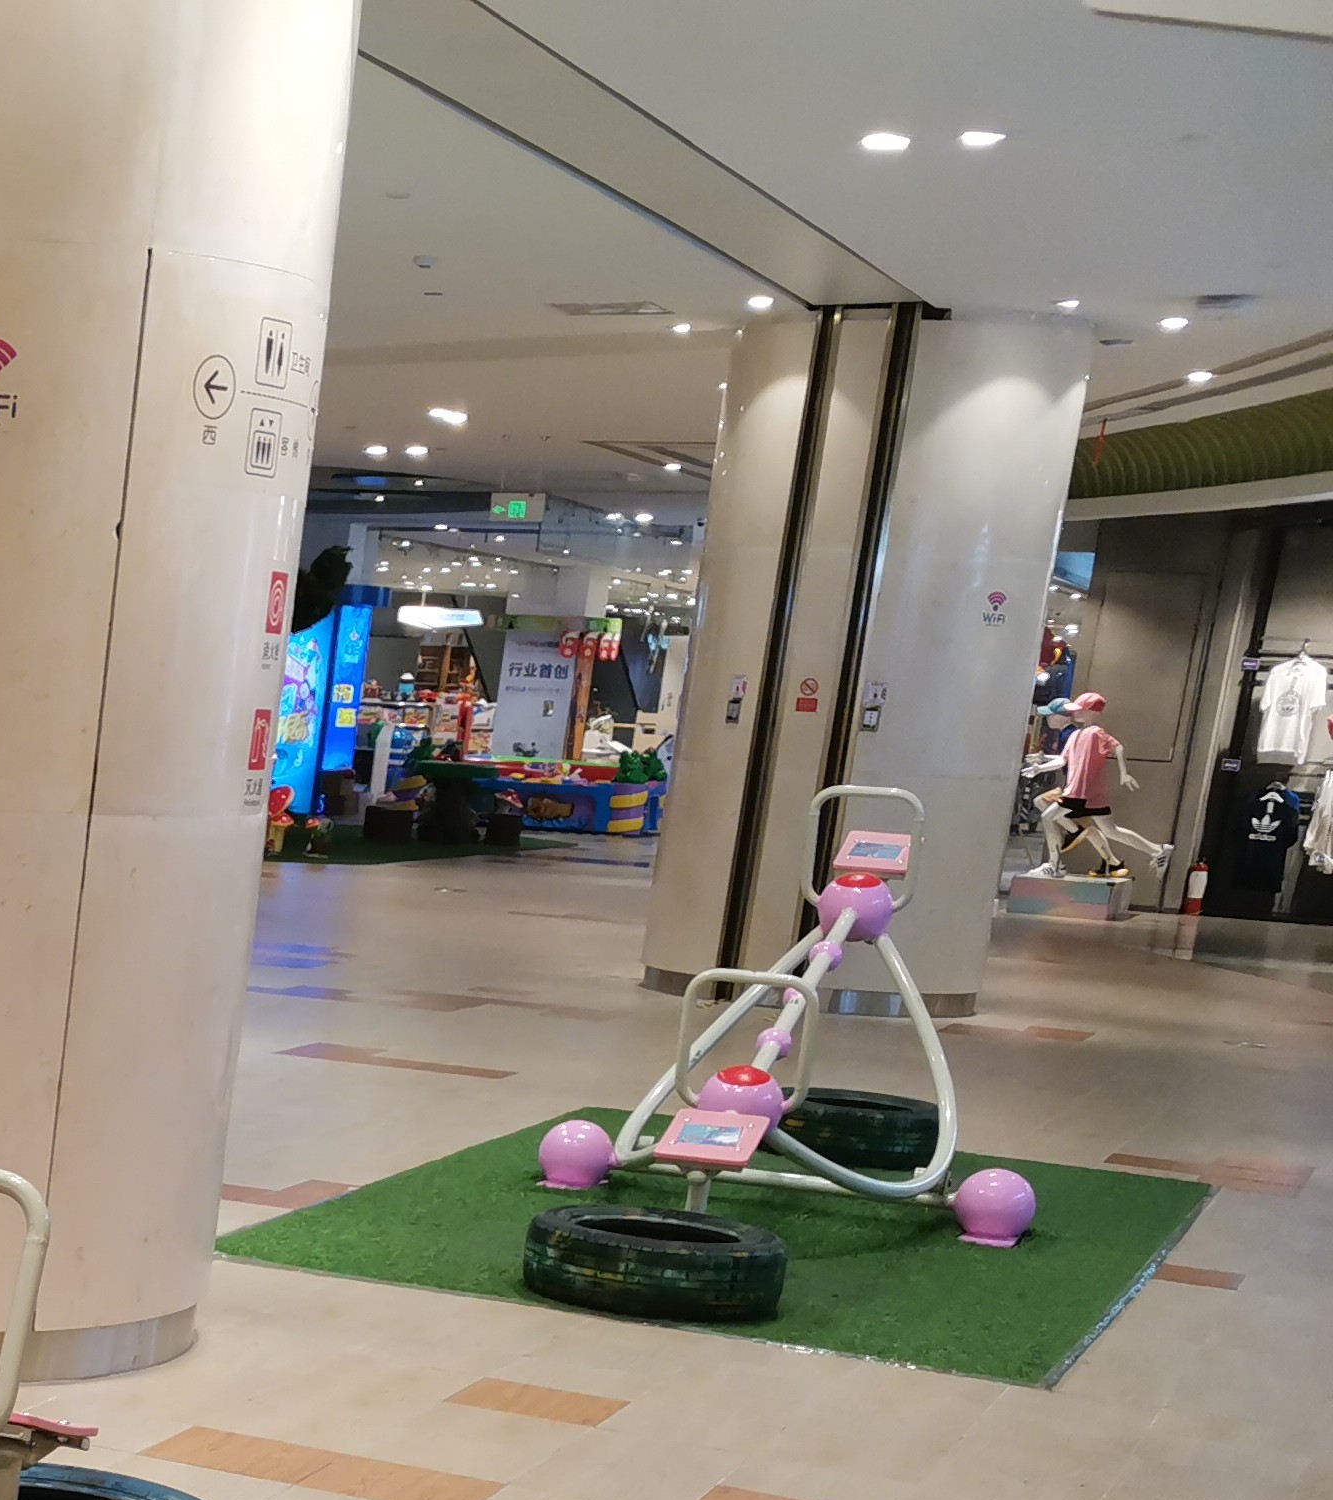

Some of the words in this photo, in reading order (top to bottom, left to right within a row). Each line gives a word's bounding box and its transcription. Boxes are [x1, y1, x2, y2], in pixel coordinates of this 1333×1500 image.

[202, 425, 218, 445] 西
[508, 661, 569, 680] 行业首创
